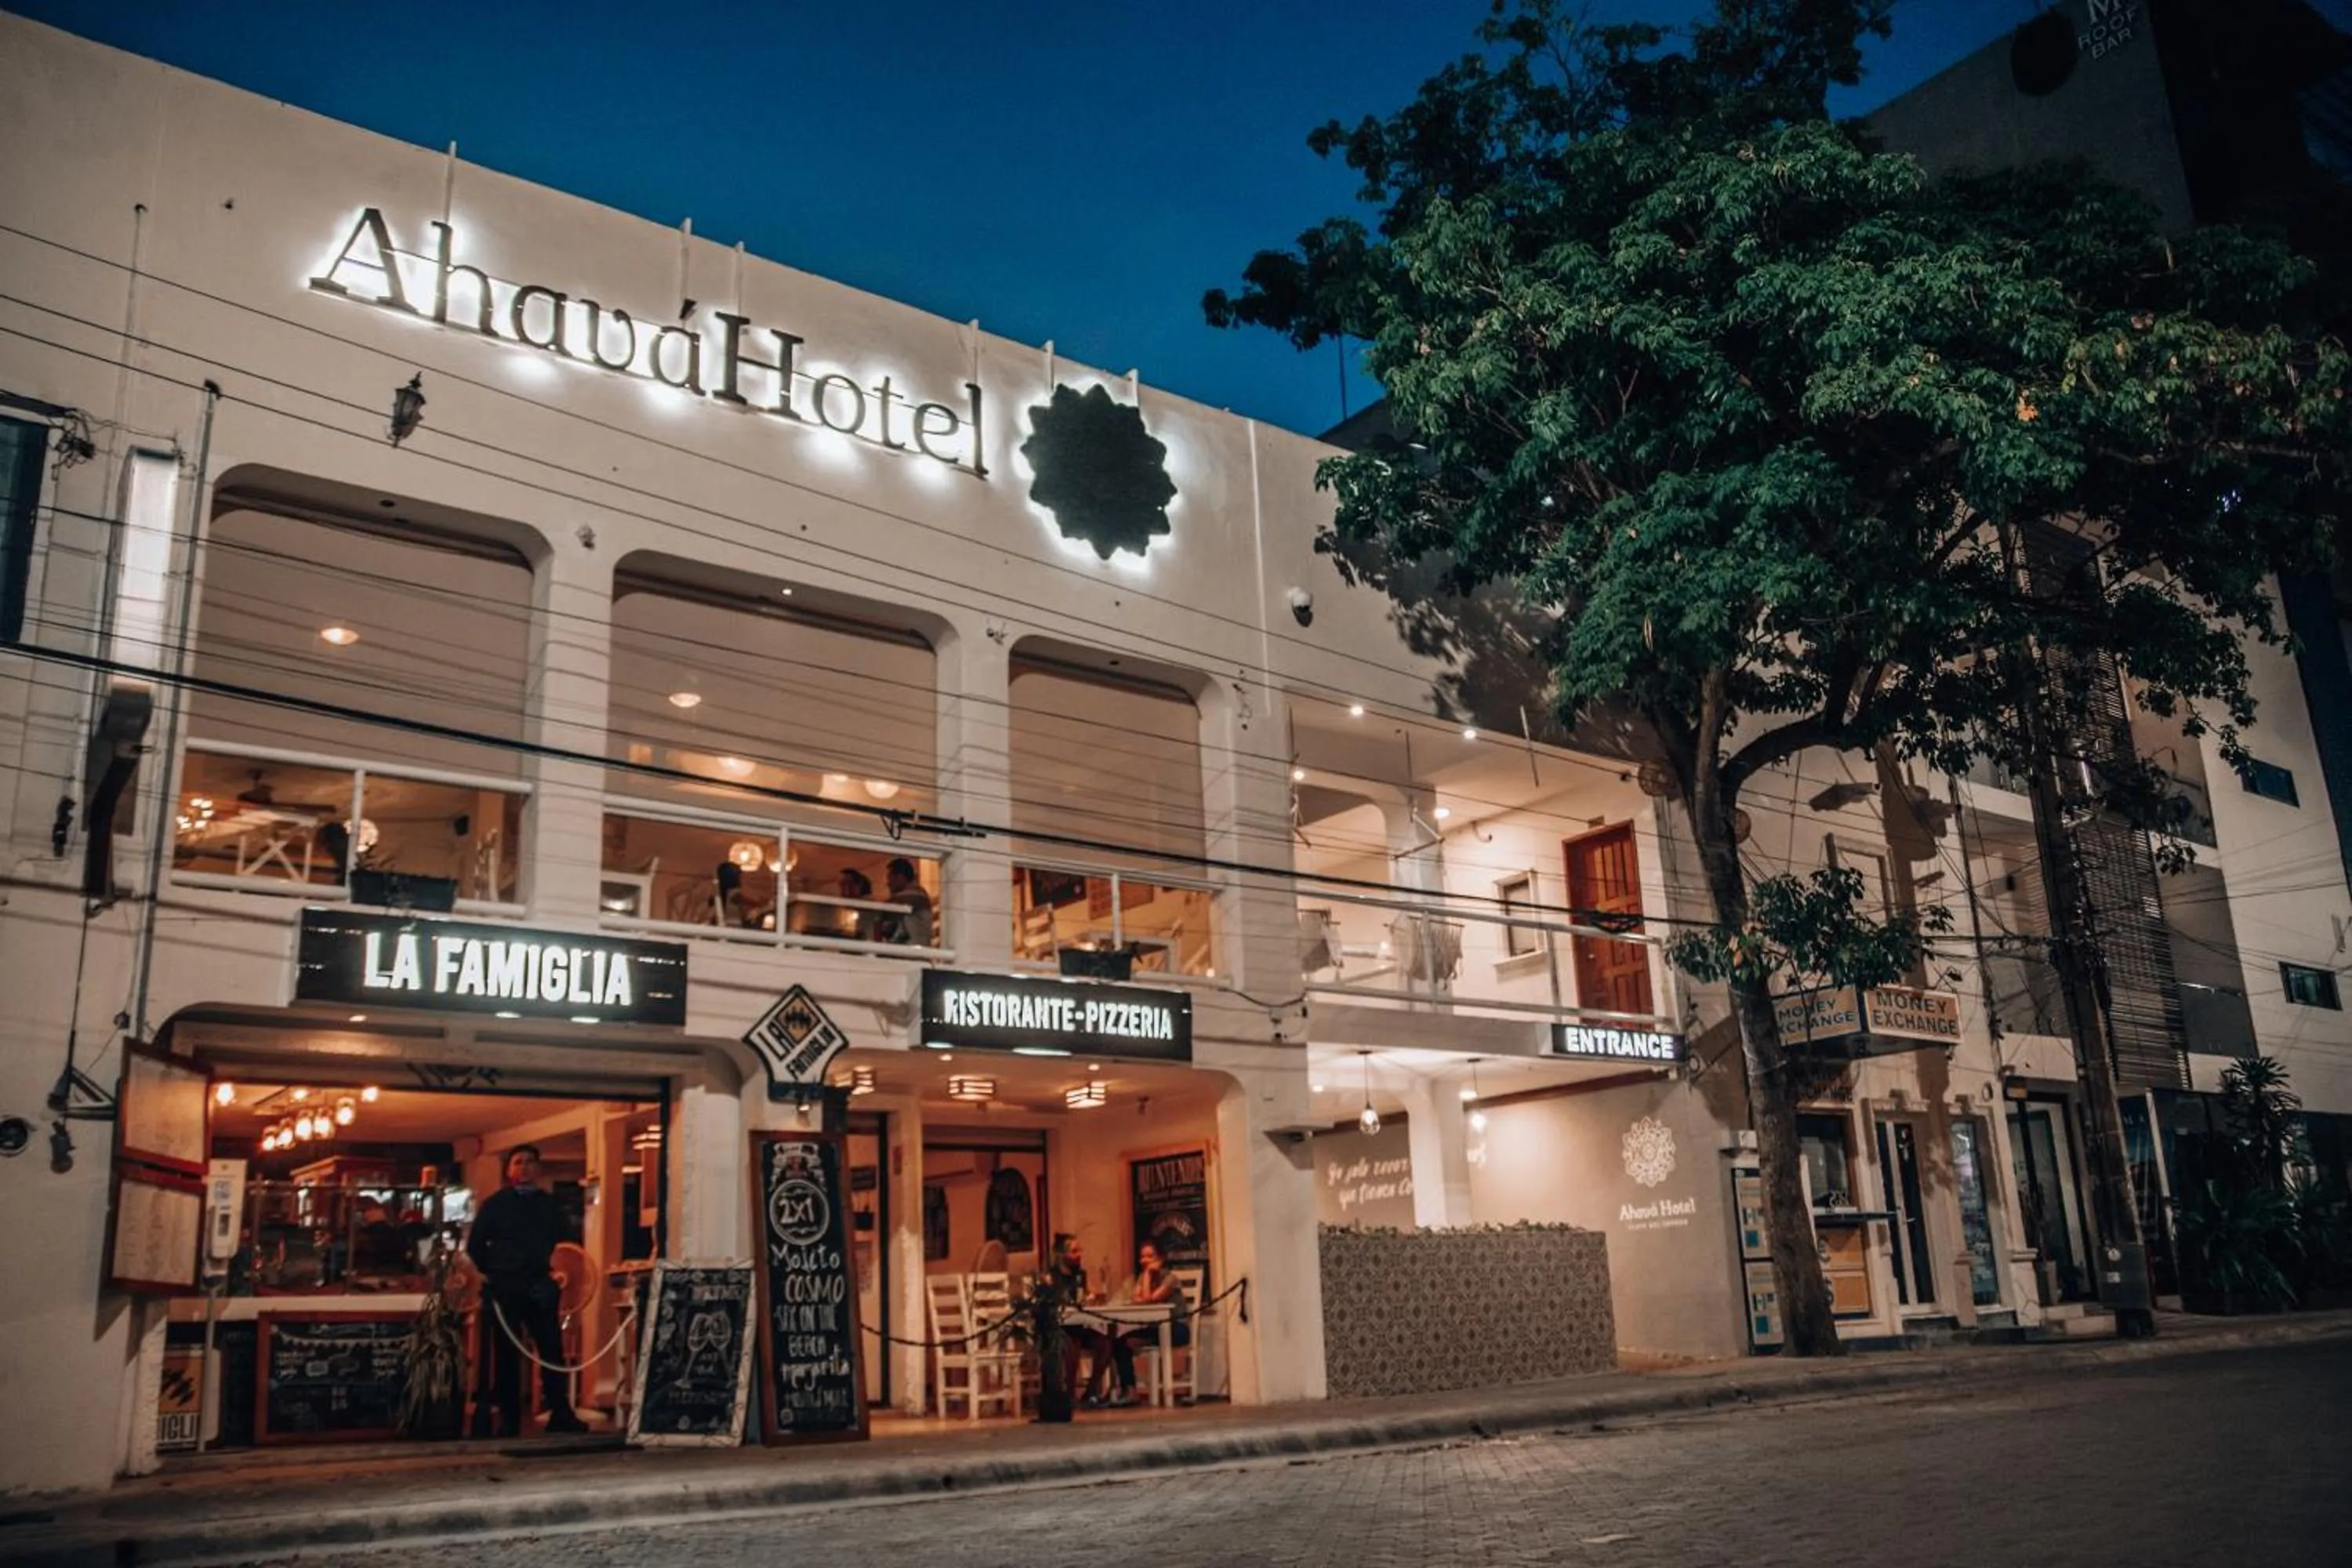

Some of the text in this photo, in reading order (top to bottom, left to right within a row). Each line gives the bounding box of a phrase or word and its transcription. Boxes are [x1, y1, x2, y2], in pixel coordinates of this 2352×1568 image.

[2092, 27, 2132, 60] BAR
[712, 311, 989, 480] Hotel
[364, 932, 632, 1005] LA FAMIGLIA
[1876, 991, 1947, 1014] MONEY
[1873, 1009, 1958, 1036] EXCHANGE
[757, 1021, 796, 1062] LA
[1566, 1027, 1675, 1058] ENTRANCE
[1659, 1197, 1696, 1216] Hotel
[785, 1274, 845, 1303] COSMO
